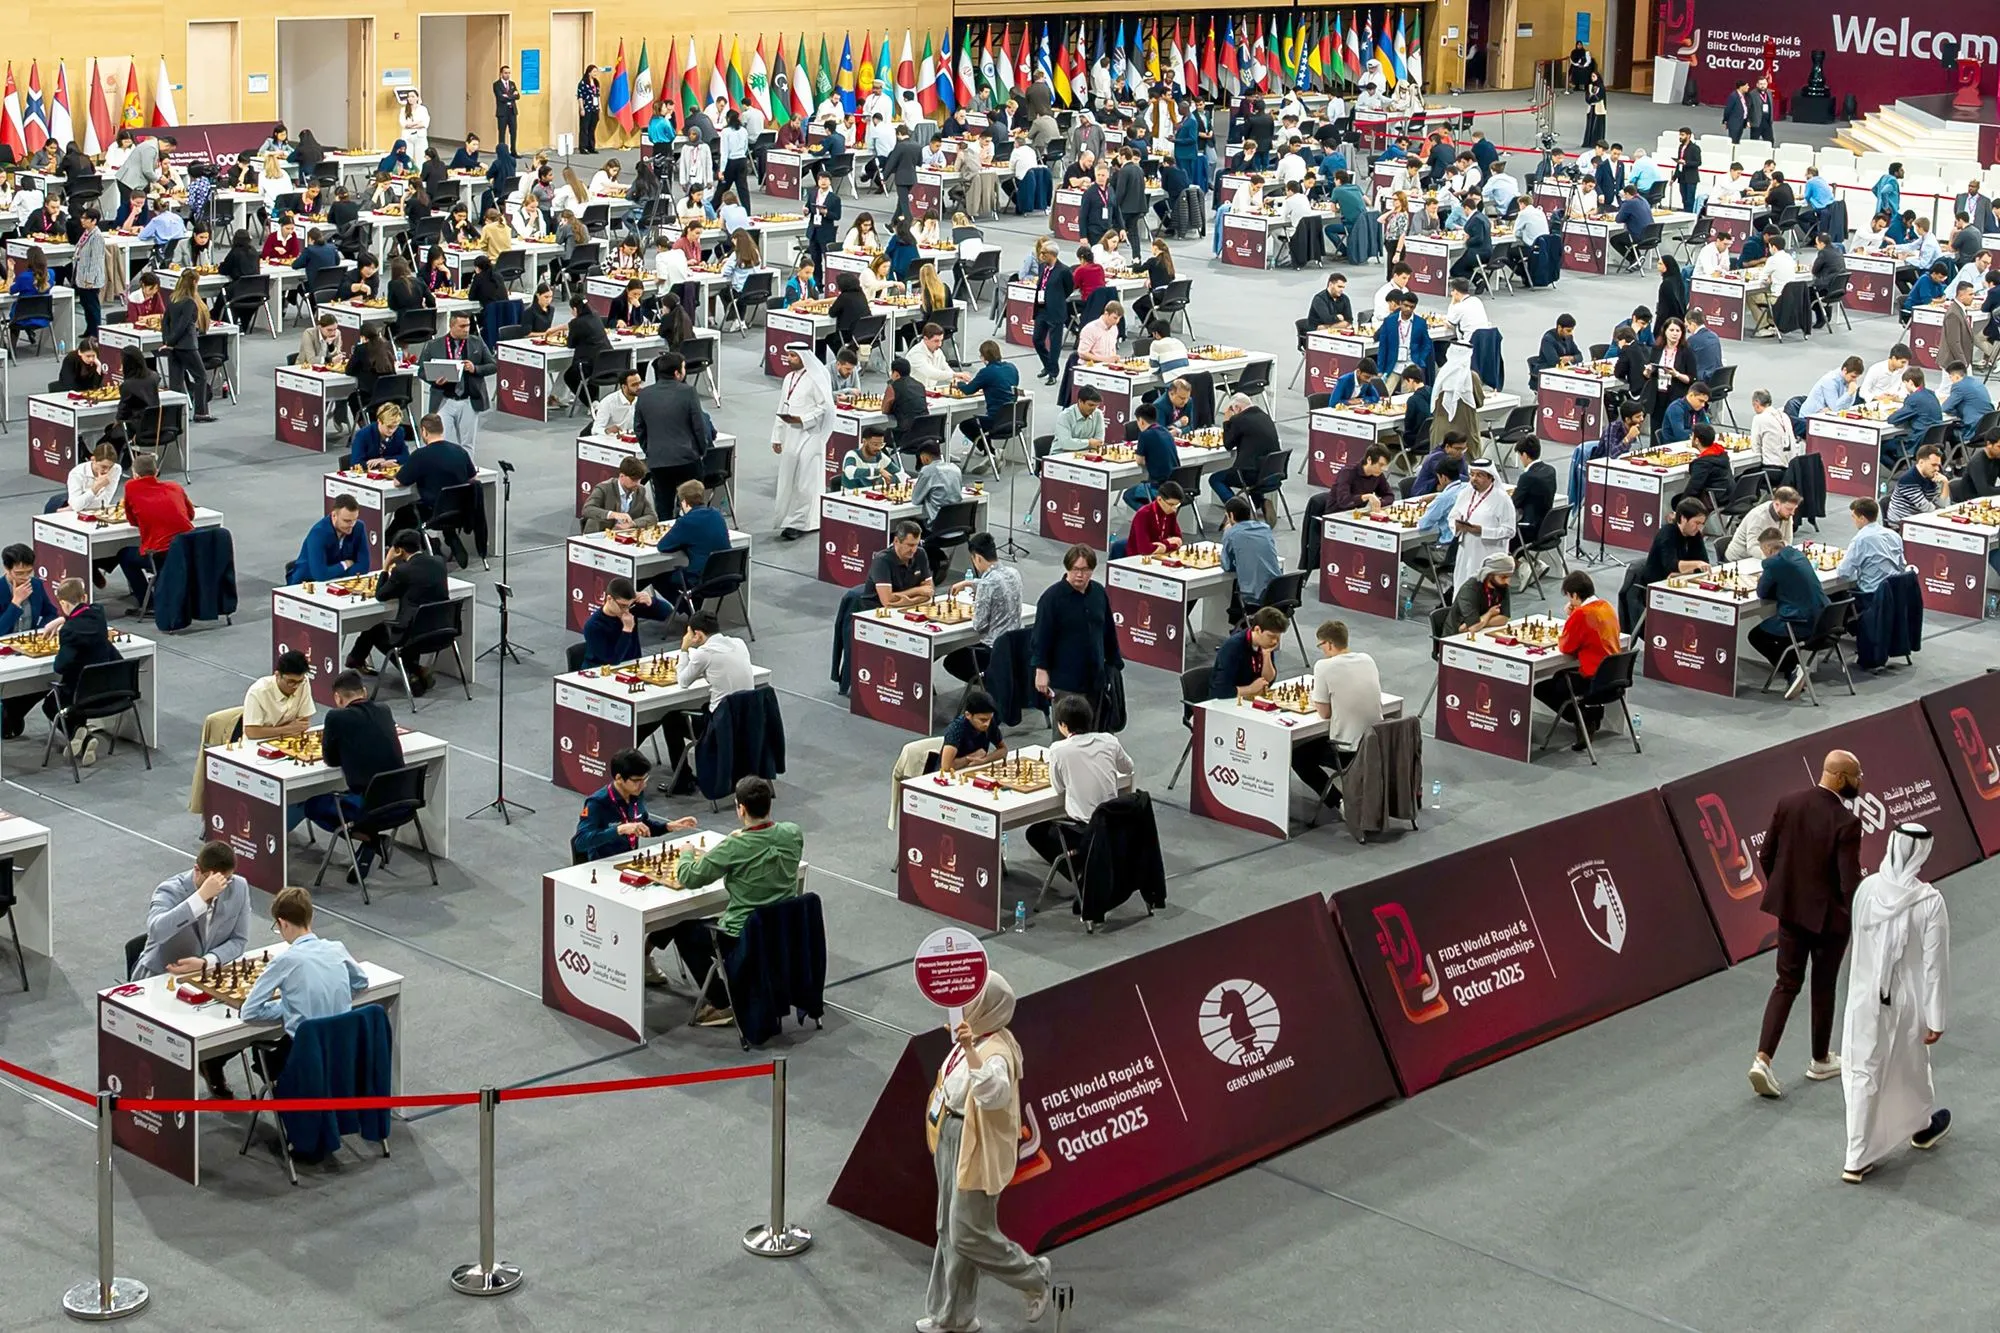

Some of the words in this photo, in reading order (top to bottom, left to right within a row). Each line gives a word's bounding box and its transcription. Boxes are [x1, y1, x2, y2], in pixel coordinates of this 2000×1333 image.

[1707, 42, 1728, 50] Blitz
[1729, 44, 1800, 58] Champiships
[1708, 30, 1729, 39] FIDE
[1732, 32, 1760, 42] World
[1794, 37, 1801, 46] &
[1706, 54, 1746, 68] Qatar
[1748, 58, 1779, 72] 205
[1438, 944, 1461, 962] FIDE
[1461, 933, 1490, 953] World
[1491, 922, 1520, 943] Rapid
[1519, 920, 1528, 932] &
[1444, 964, 1467, 979] Blitz
[1467, 938, 1535, 971] Championships
[1453, 978, 1493, 1006] Qatar
[1491, 962, 1525, 990] 2025
[1226, 1074, 1249, 1092] GENS
[1248, 1068, 1267, 1083] UNA
[1266, 1056, 1295, 1076] SUMUS
[1242, 1049, 1265, 1068] FIDE
[1041, 1089, 1070, 1111] FIDE
[1070, 1074, 1108, 1099] World
[1108, 1059, 1144, 1084] Rapid
[1144, 1056, 1154, 1070] &
[1048, 1111, 1076, 1131] Blitz
[1076, 1077, 1163, 1119] Championships
[1058, 1126, 1108, 1161] Qatar
[1108, 1106, 1149, 1139] 2025
